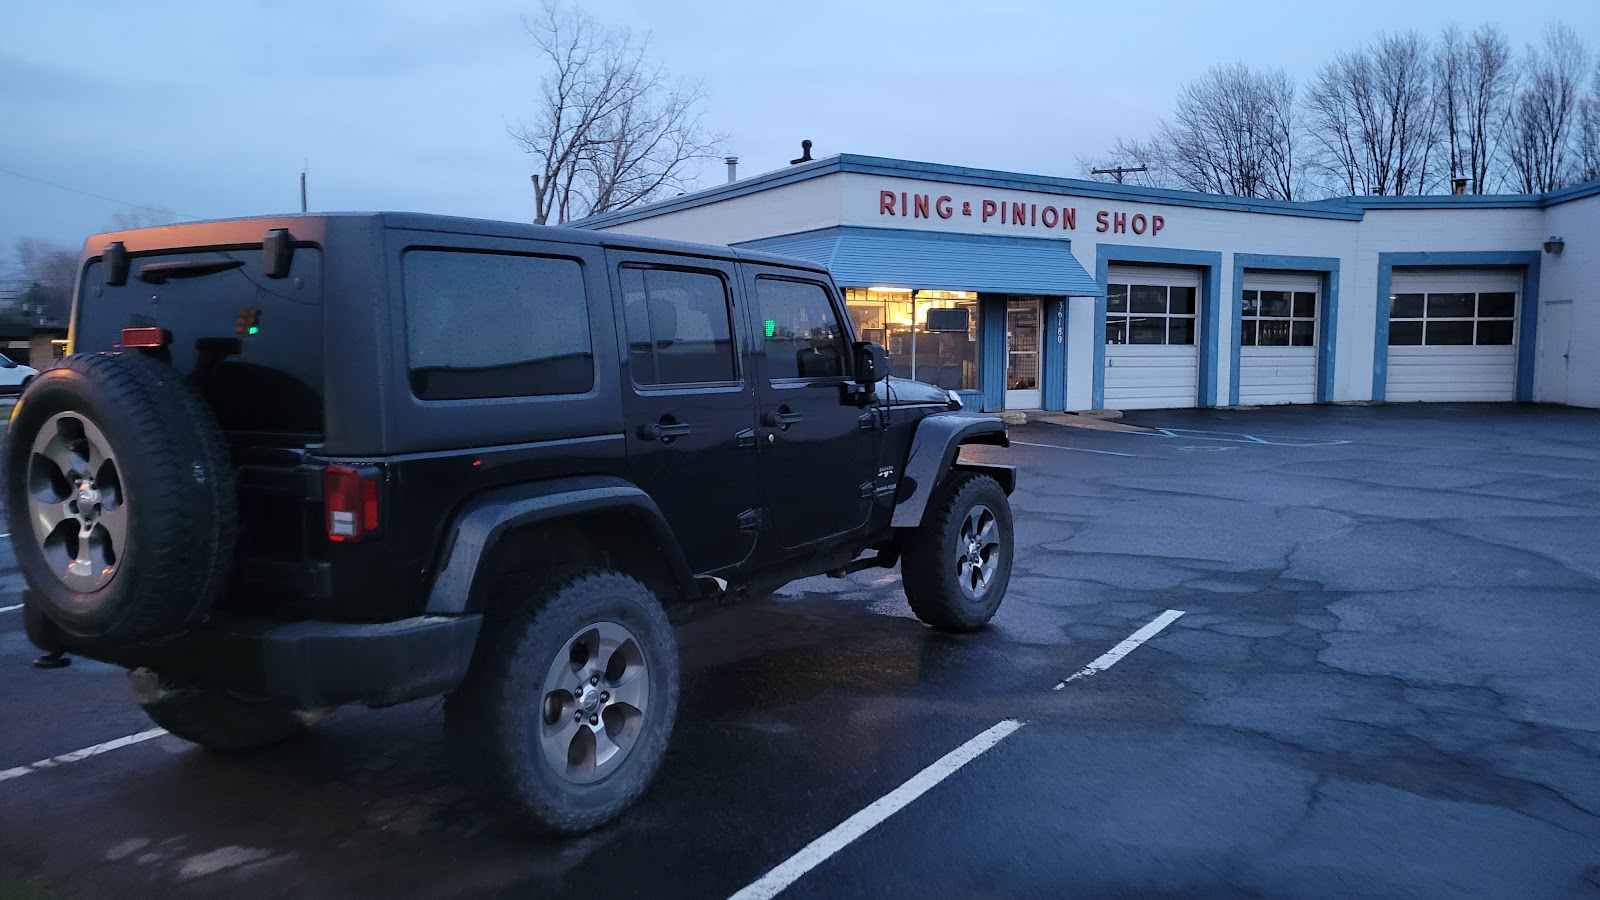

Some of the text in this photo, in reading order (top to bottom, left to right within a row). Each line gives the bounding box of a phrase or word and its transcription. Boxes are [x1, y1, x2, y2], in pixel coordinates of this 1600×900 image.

[880, 190, 1165, 236] RING & PINION SHOP
